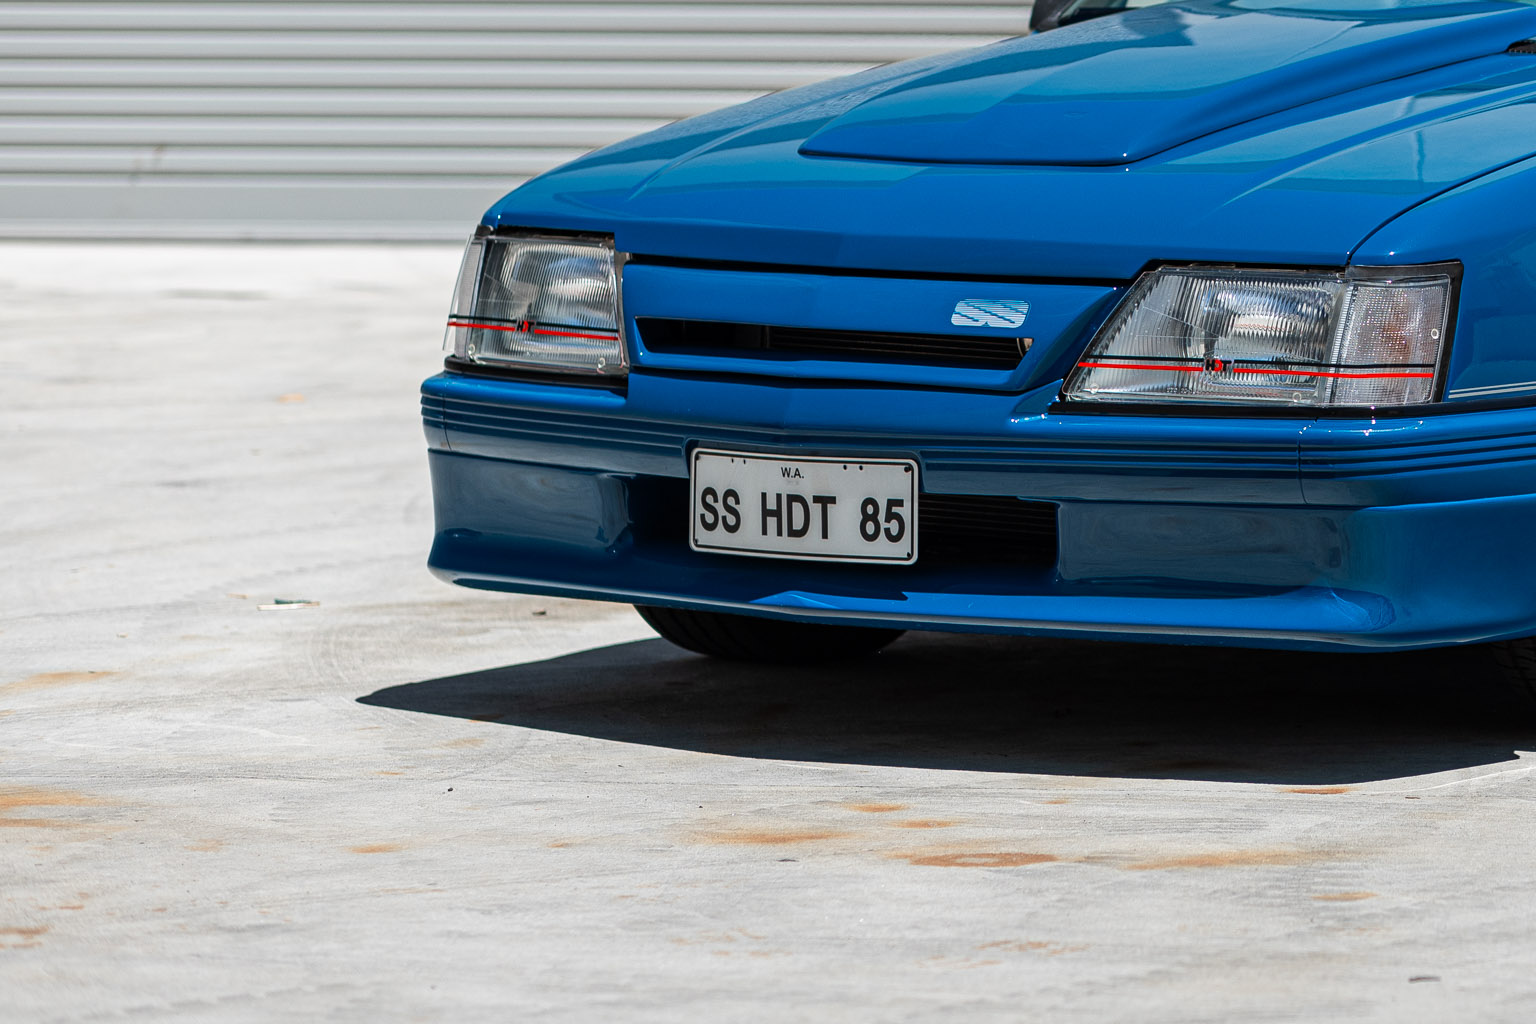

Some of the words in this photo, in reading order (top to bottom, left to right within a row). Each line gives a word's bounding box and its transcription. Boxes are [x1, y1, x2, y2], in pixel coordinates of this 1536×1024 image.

[1205, 358, 1232, 372] HDT
[780, 467, 805, 479] W.A.
[700, 486, 742, 534] SS
[761, 491, 837, 540] HDT
[859, 496, 906, 543] 85
